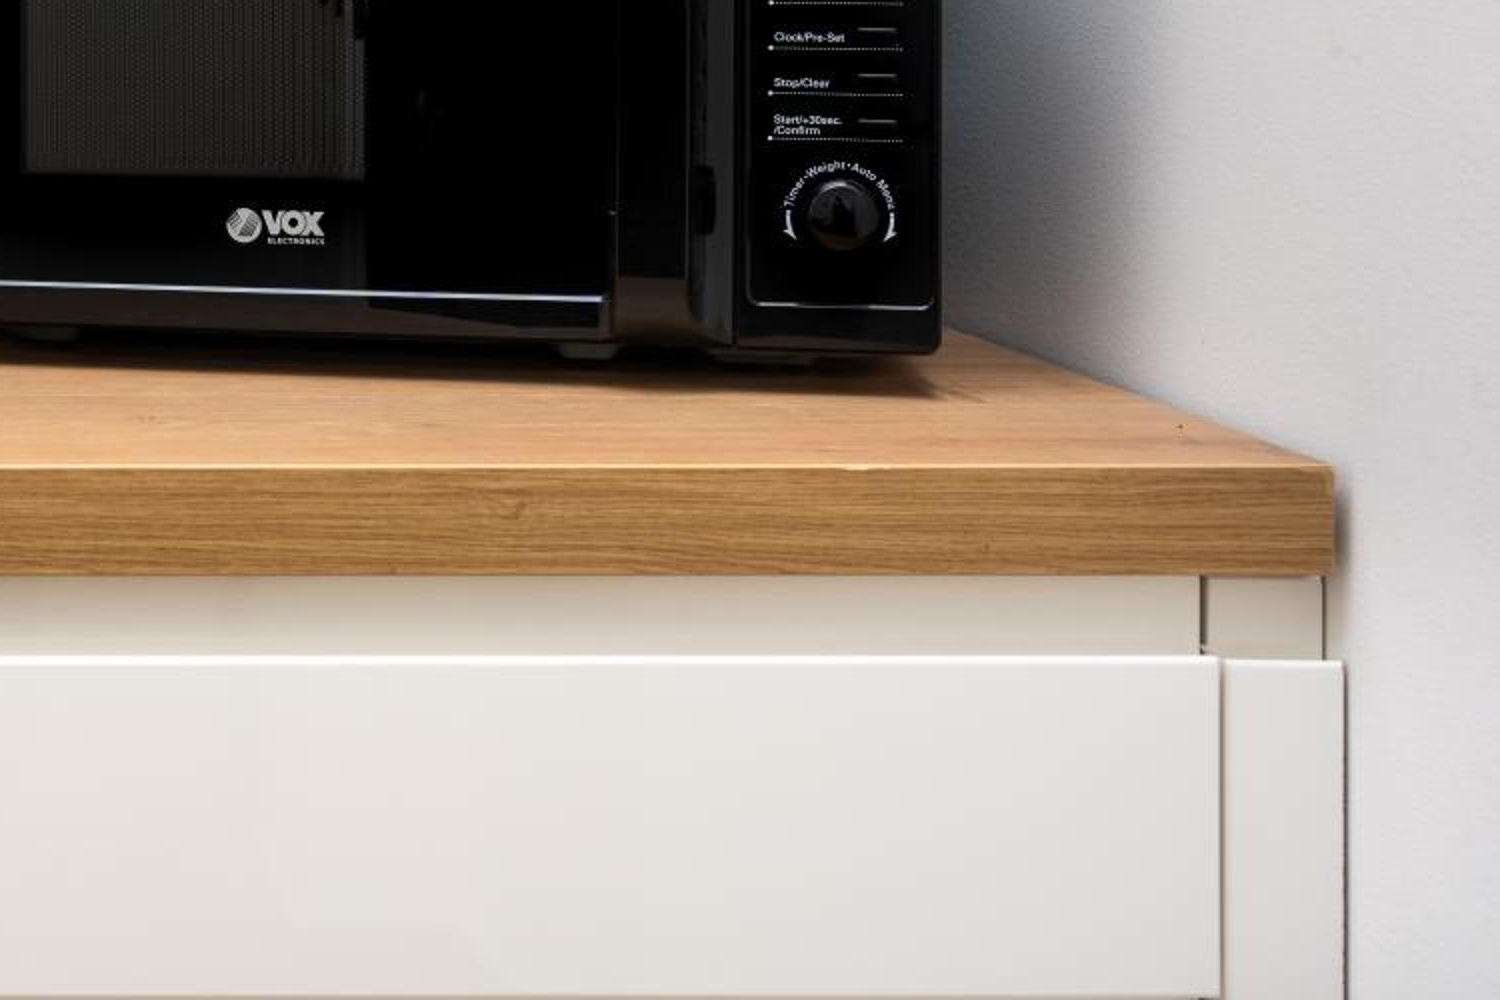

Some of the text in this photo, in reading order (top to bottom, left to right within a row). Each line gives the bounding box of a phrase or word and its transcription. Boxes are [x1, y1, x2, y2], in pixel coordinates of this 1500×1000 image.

[773, 32, 845, 43] Clock/Pre-Set
[773, 77, 831, 88] Stop/Clear
[876, 179, 896, 210] Menu
[261, 209, 325, 236] VOX
